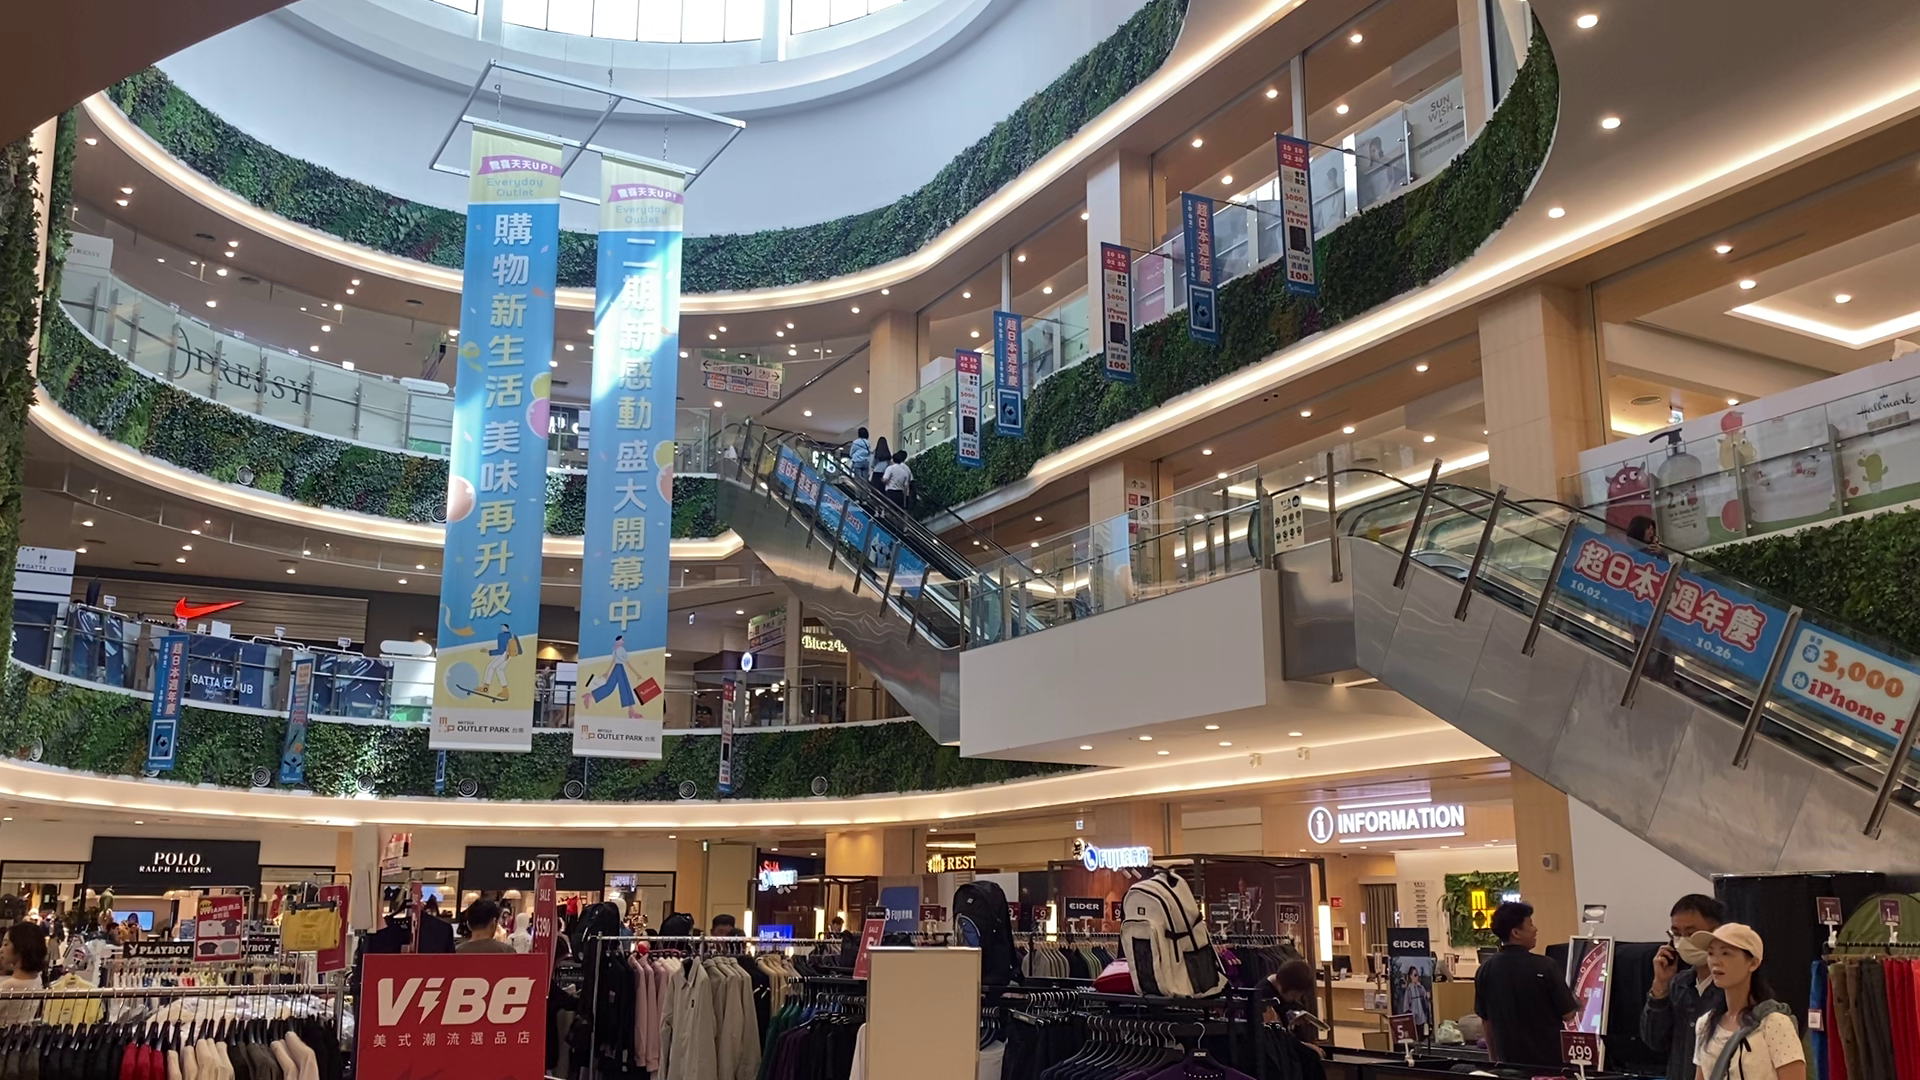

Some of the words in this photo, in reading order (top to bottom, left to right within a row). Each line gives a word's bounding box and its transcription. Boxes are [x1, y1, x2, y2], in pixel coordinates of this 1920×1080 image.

[1430, 93, 1450, 112] SUN
[1428, 102, 1454, 122] WISH
[487, 178, 543, 188] Everyday
[496, 188, 534, 197] Outlet
[615, 205, 668, 215] Everyday
[1285, 209, 1308, 220] iPhone
[625, 215, 660, 224] Outlet
[1289, 271, 1308, 281] 100
[194, 347, 311, 405] DRESSY
[1857, 392, 1917, 420] Hallmark
[1569, 579, 1601, 600] 10.02
[1576, 543, 1763, 648] 超日本週年慶
[1696, 637, 1732, 660] 10.26
[164, 642, 183, 716] 超日本週年慶
[1818, 650, 1904, 698] 3,000
[1808, 678, 1886, 725] iPhone
[457, 725, 488, 733] OUTLET
[597, 733, 624, 741] OUTLET
[625, 734, 643, 742] PARK
[1337, 804, 1465, 834] INFORMATION
[154, 852, 201, 867] POLO
[516, 859, 556, 872] POLO
[947, 855, 977, 870] REST
[139, 865, 171, 873] RALPH
[175, 866, 212, 874] LAUREN
[539, 889, 551, 901] SALE
[1069, 902, 1100, 911] EIDER
[1280, 912, 1299, 922] 1980
[140, 945, 190, 955] PLAYBOY
[1392, 940, 1425, 949] EIDER
[373, 1030, 531, 1048] 美式潮流選品店
[1568, 1045, 1593, 1060] 499
